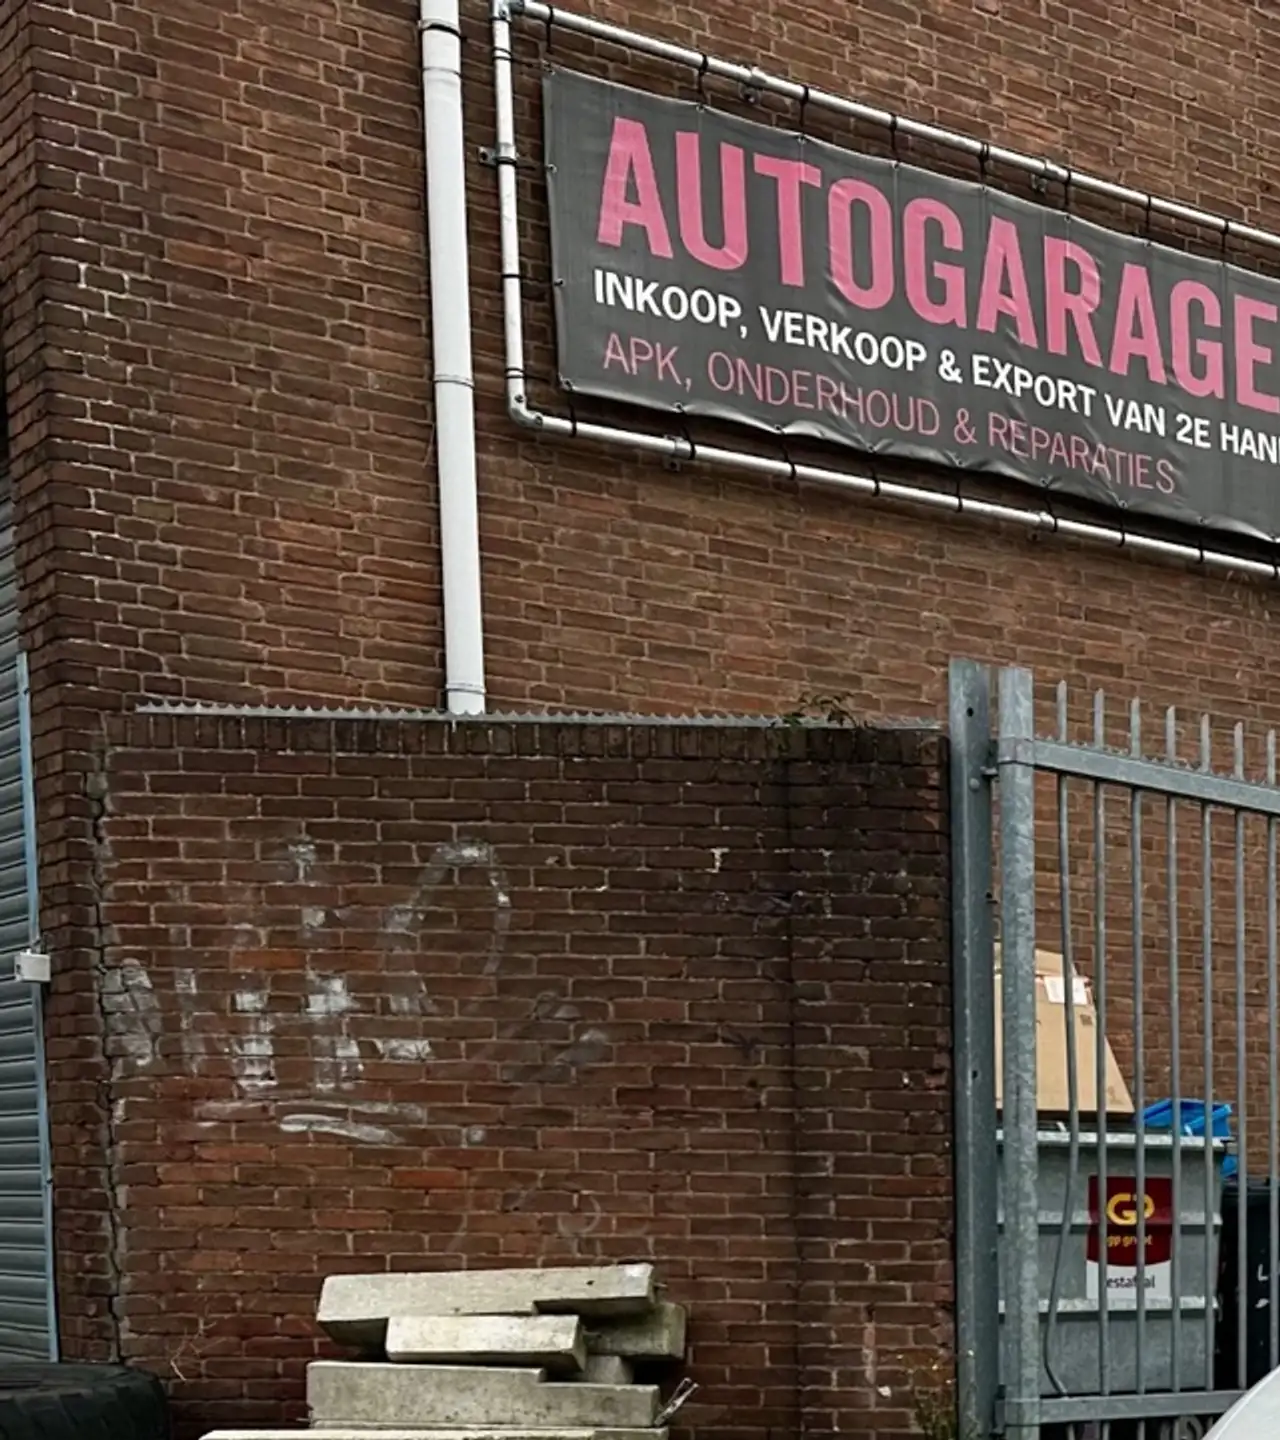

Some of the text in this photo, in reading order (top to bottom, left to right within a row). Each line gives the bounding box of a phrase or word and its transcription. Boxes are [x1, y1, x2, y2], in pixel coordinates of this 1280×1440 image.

[597, 116, 1280, 413] AUTOGARAGE
[593, 268, 748, 339] INKOOP,
[758, 305, 927, 371] VERKOOP
[938, 349, 963, 384] &
[972, 354, 1098, 417] EXPORT
[1104, 393, 1166, 437] VAN
[1175, 413, 1212, 449] 2E
[603, 332, 1176, 494] APK, ONDERHOUD & REPARATIES
